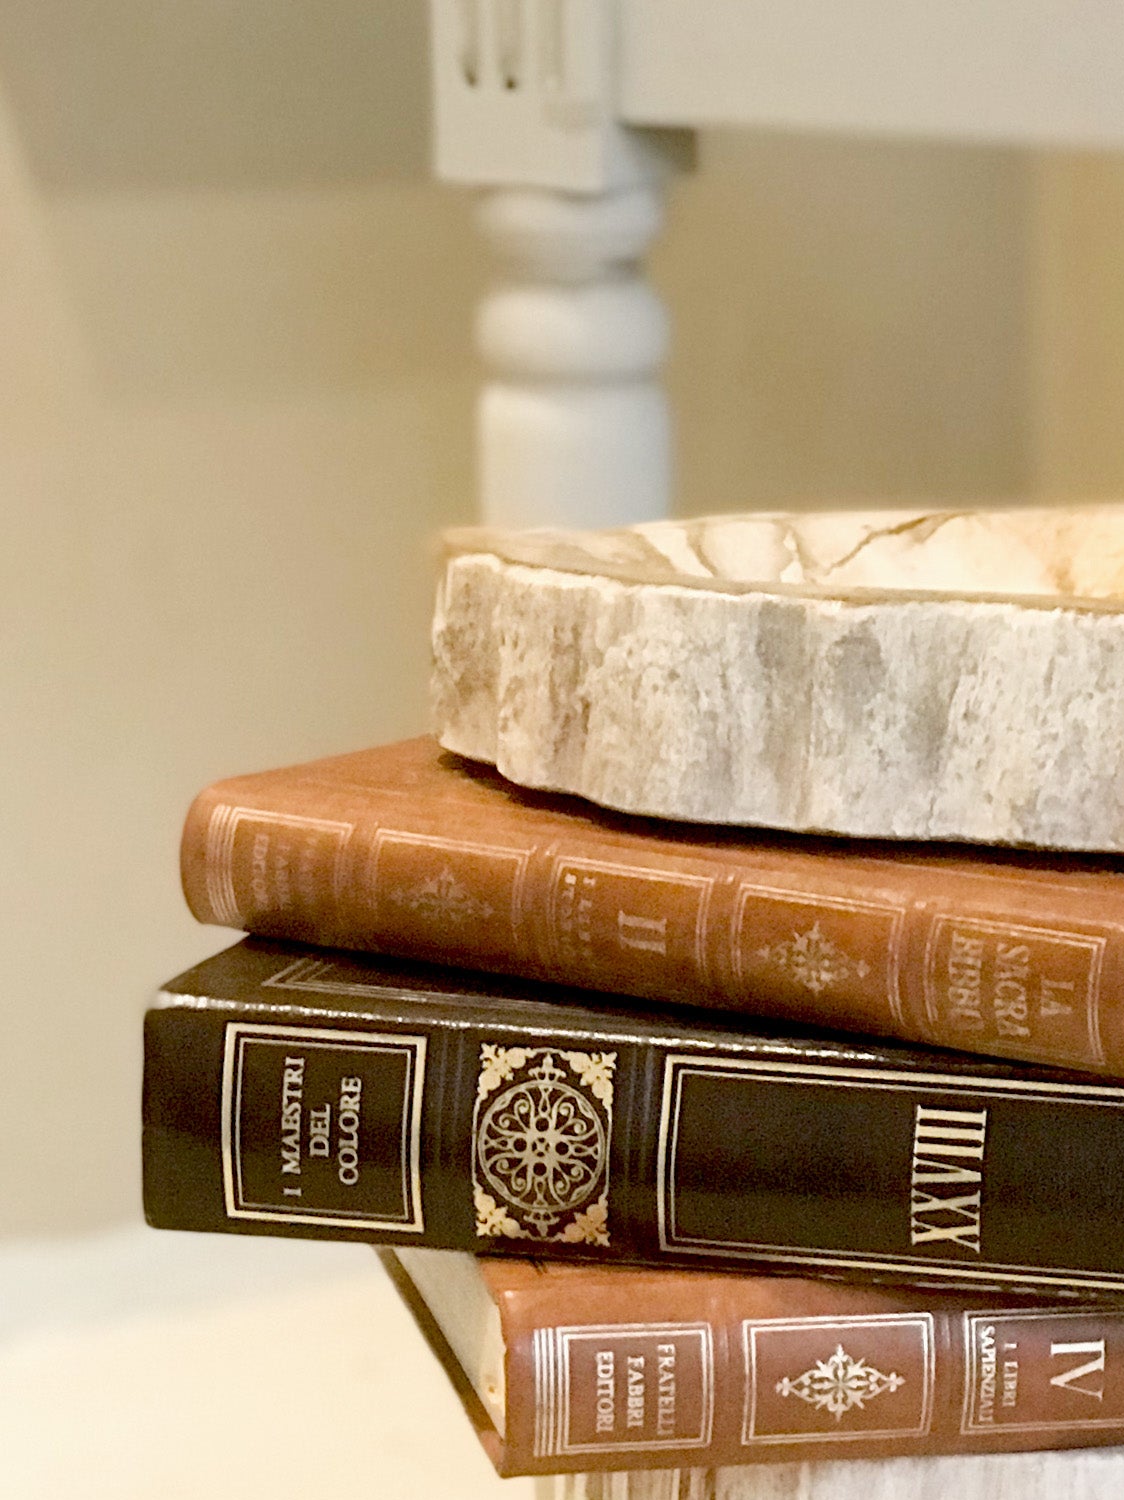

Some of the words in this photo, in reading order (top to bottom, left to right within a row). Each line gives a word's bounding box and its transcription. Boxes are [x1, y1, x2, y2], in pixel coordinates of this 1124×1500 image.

[618, 910, 667, 956] II
[995, 943, 1031, 1037] SACRA
[1041, 978, 1074, 1016] LA
[281, 1056, 304, 1175] MAESTRI
[310, 1103, 330, 1158] DEL
[339, 1077, 362, 1185] COLORE
[283, 1188, 302, 1198] I
[910, 1104, 987, 1254] XXVIII
[595, 1351, 615, 1433] EDITORI
[627, 1356, 644, 1428] FABBRI
[657, 1343, 675, 1436] FRATELLI
[979, 1325, 996, 1423] SAPIENZIALI
[1002, 1361, 1018, 1407] LIBRI
[1050, 1339, 1105, 1401] IV
